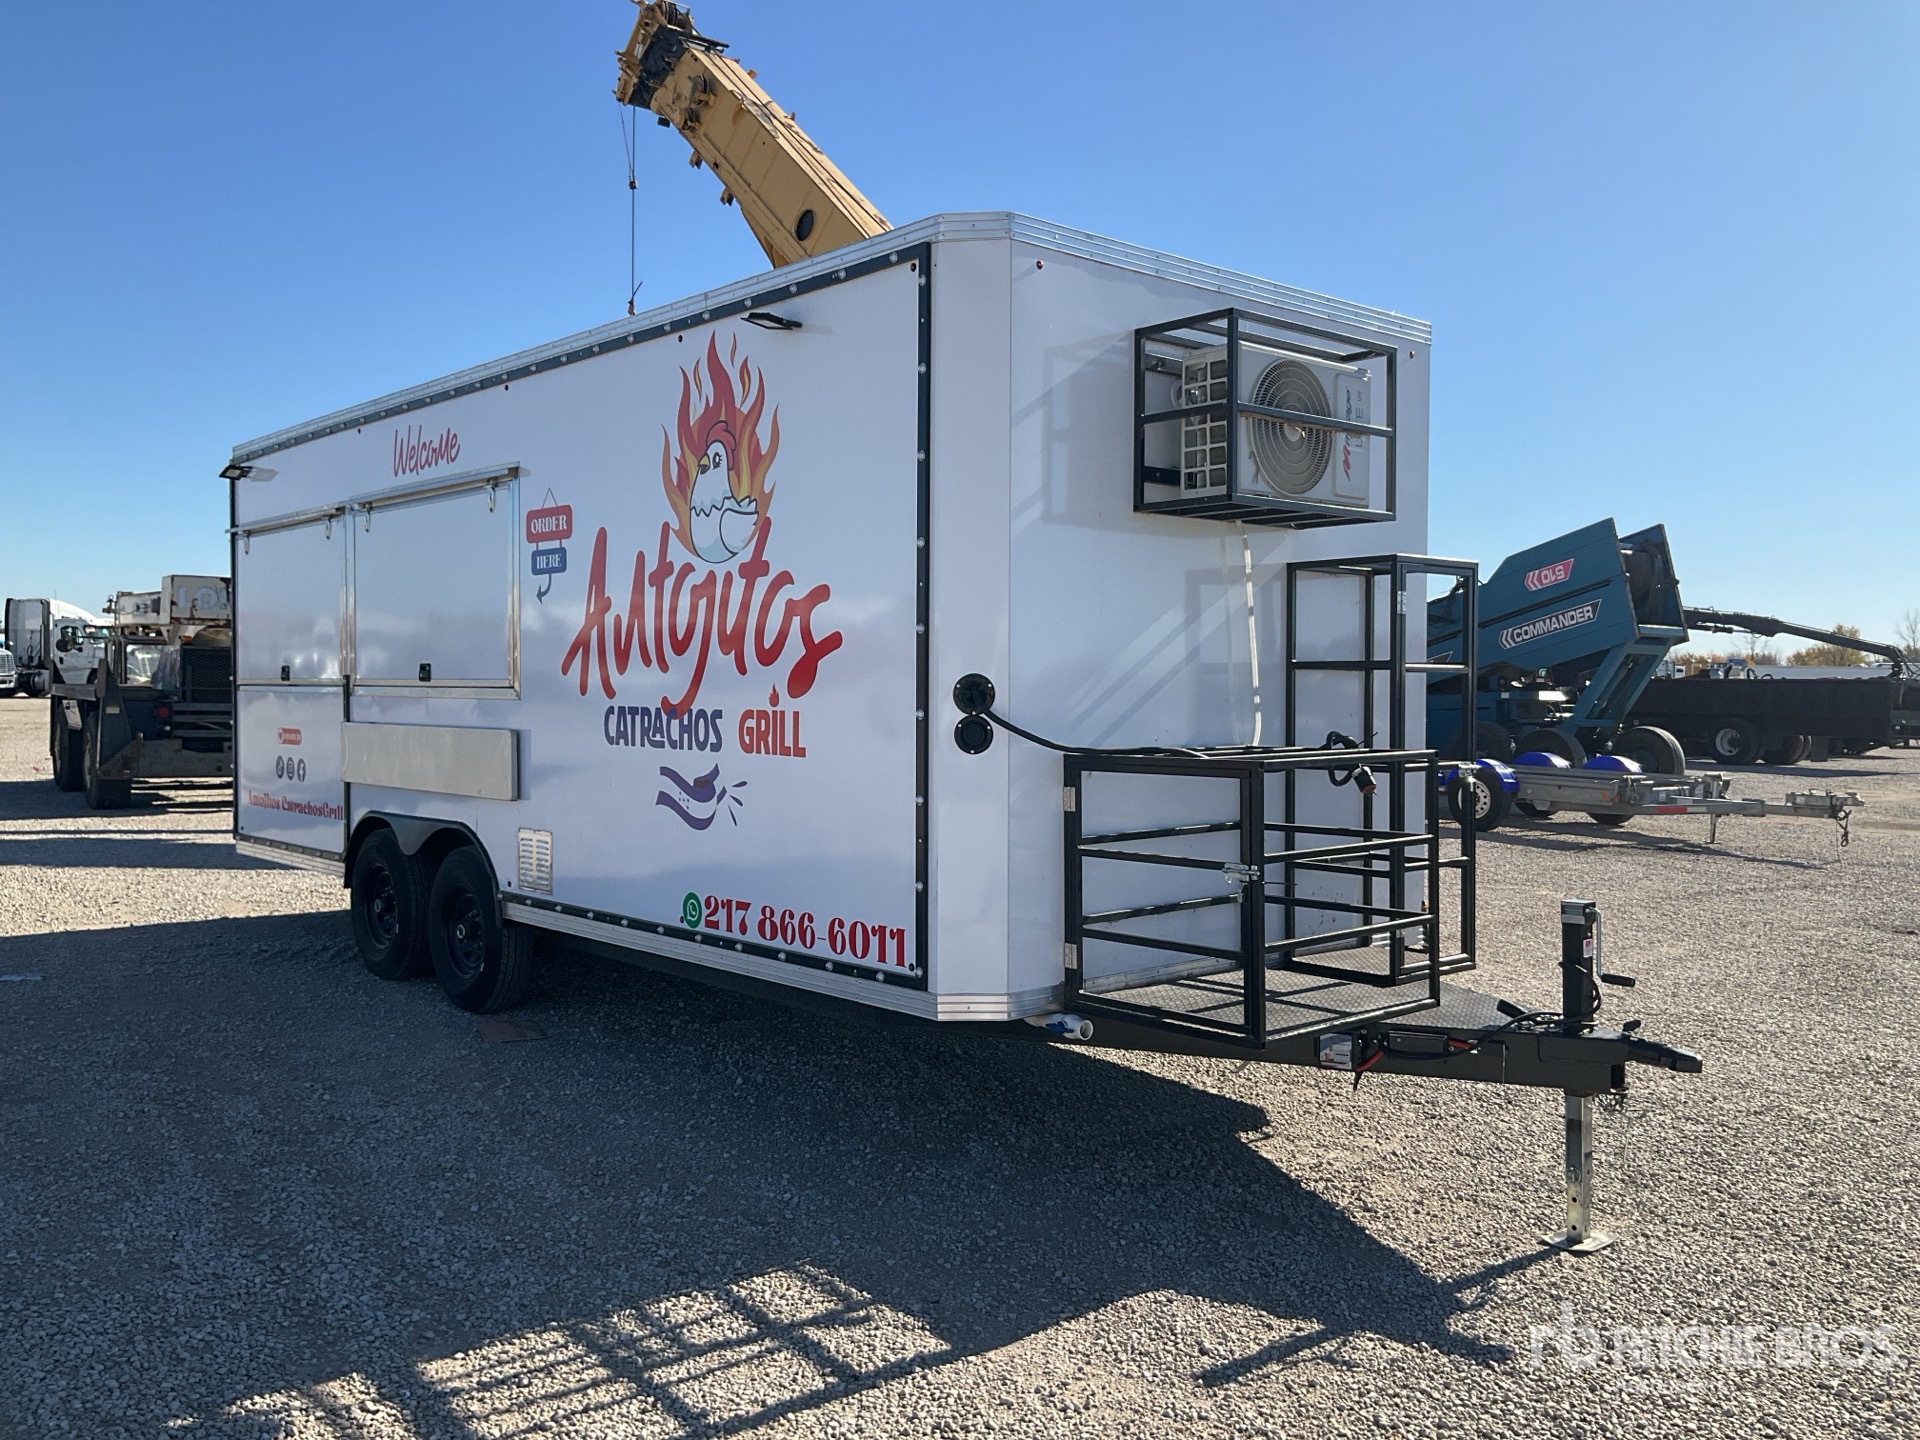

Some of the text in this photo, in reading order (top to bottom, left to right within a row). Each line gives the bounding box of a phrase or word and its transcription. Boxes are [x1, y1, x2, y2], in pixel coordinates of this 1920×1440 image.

[393, 424, 461, 477] Welcome
[530, 513, 568, 534] ORDER
[535, 552, 562, 570] HERE
[1513, 606, 1594, 642] COMMANDER
[603, 705, 808, 759] CATRACHOS GRILL
[704, 894, 907, 968] 217 866-6011
